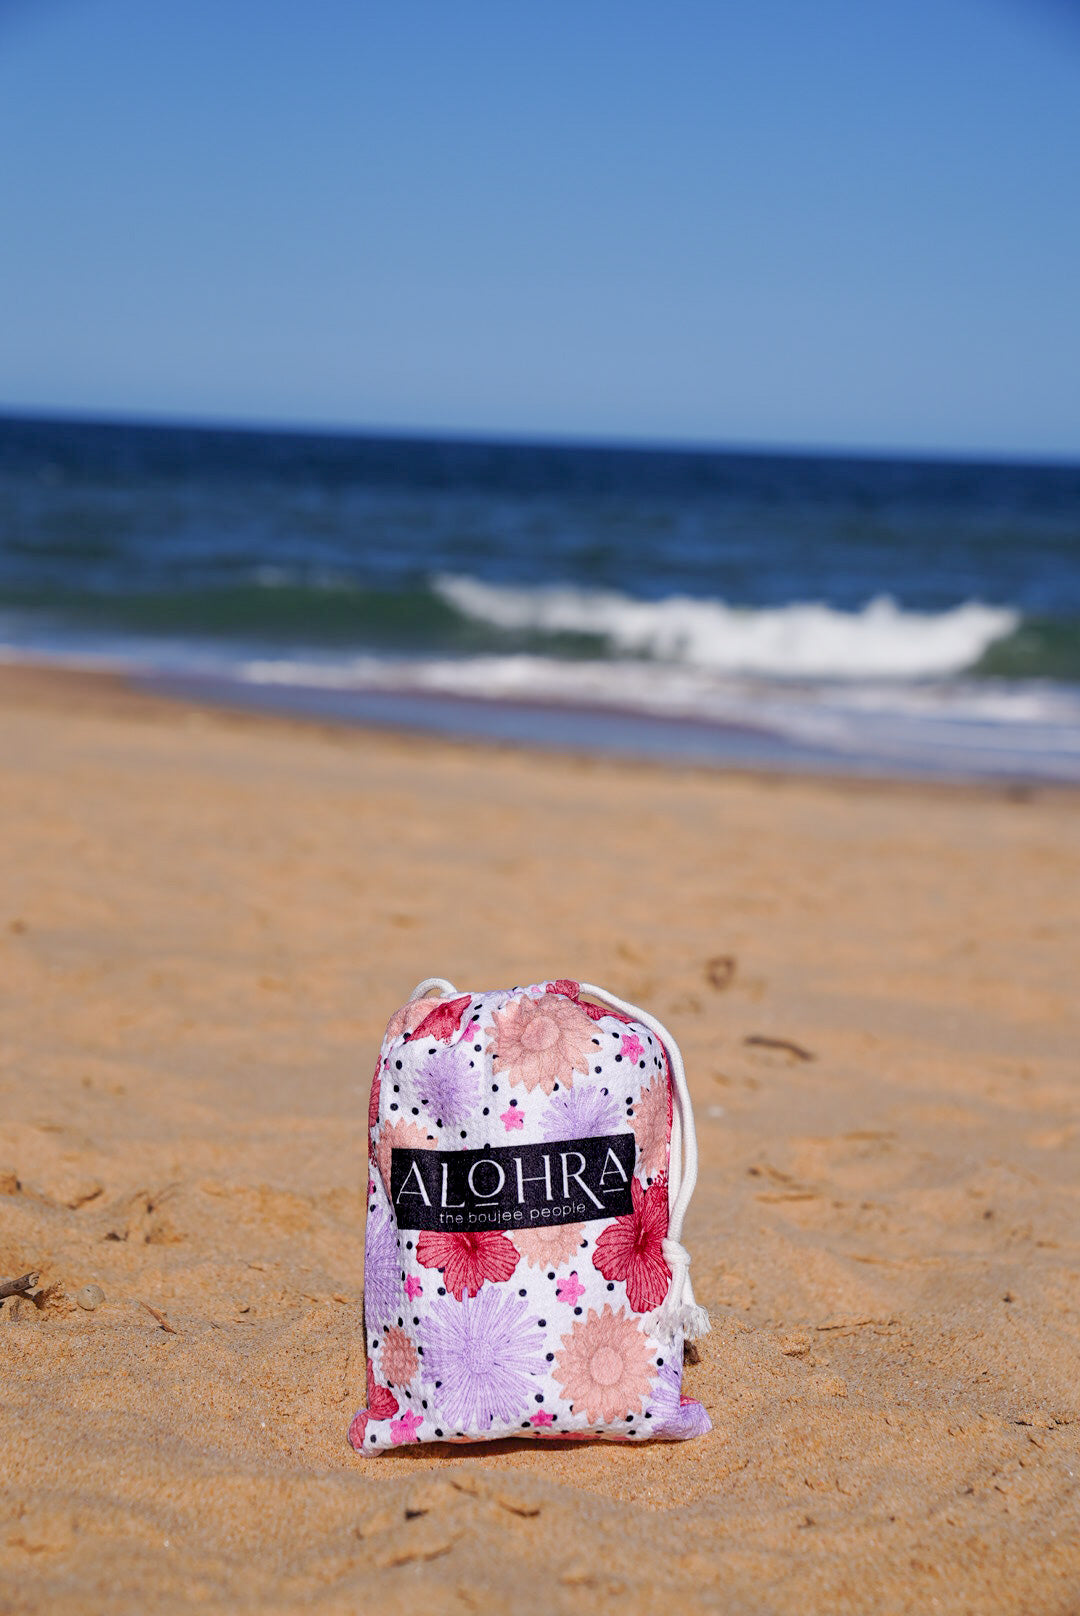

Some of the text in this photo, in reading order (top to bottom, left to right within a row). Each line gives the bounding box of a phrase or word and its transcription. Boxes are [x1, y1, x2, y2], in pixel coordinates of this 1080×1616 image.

[396, 1147, 628, 1209] ALOHRA
[439, 1201, 586, 1224] the boujee people
